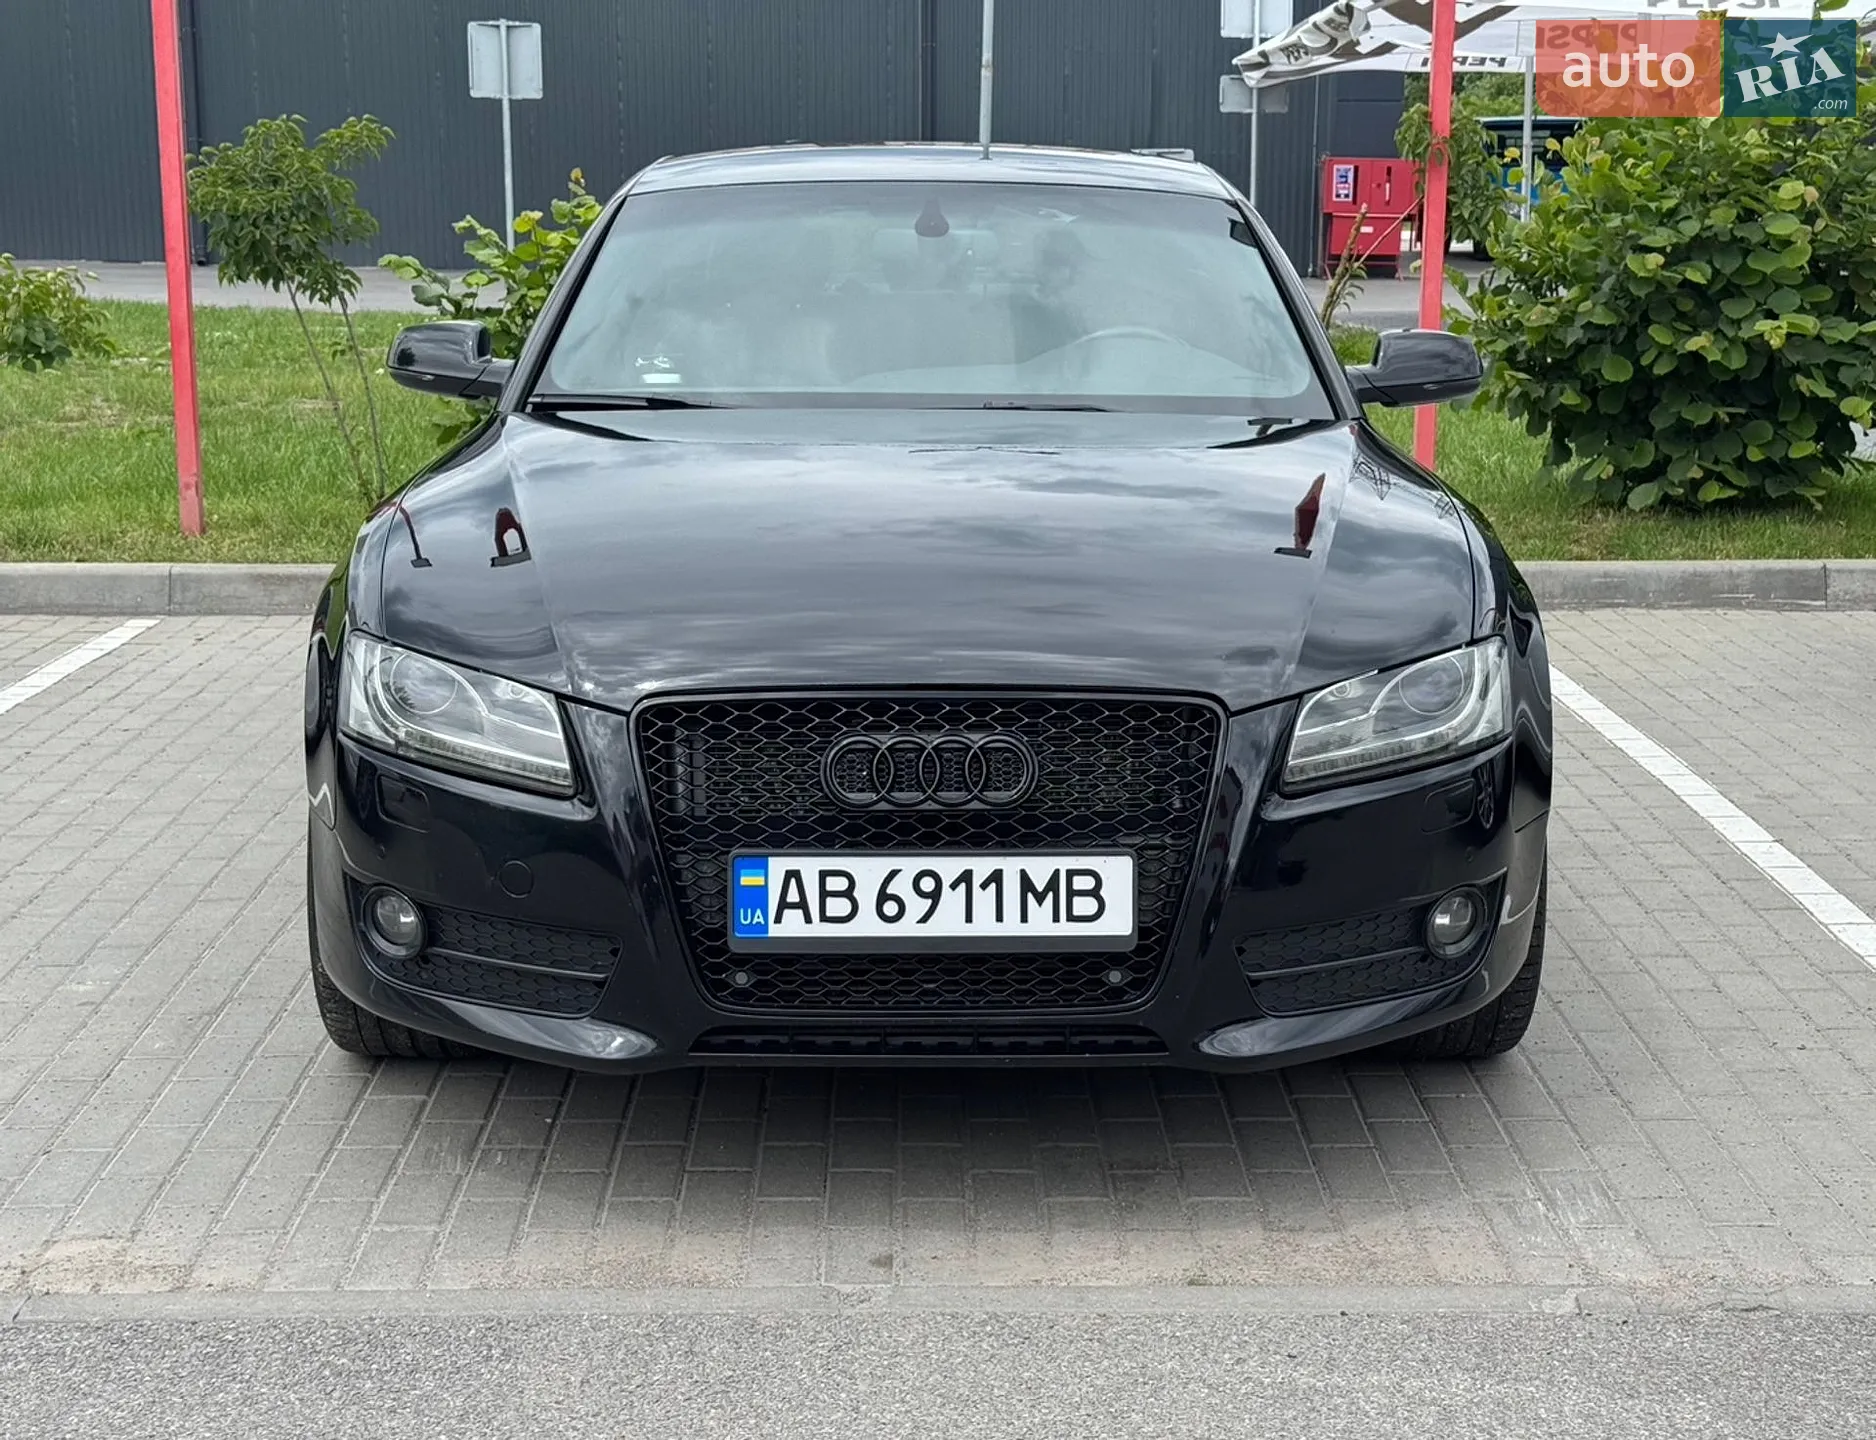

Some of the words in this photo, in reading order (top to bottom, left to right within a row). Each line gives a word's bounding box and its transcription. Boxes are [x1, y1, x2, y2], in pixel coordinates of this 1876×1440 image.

[773, 868, 860, 924] AB
[875, 868, 1004, 924] 6911
[1019, 868, 1106, 924] MB
[740, 907, 765, 925] UA
